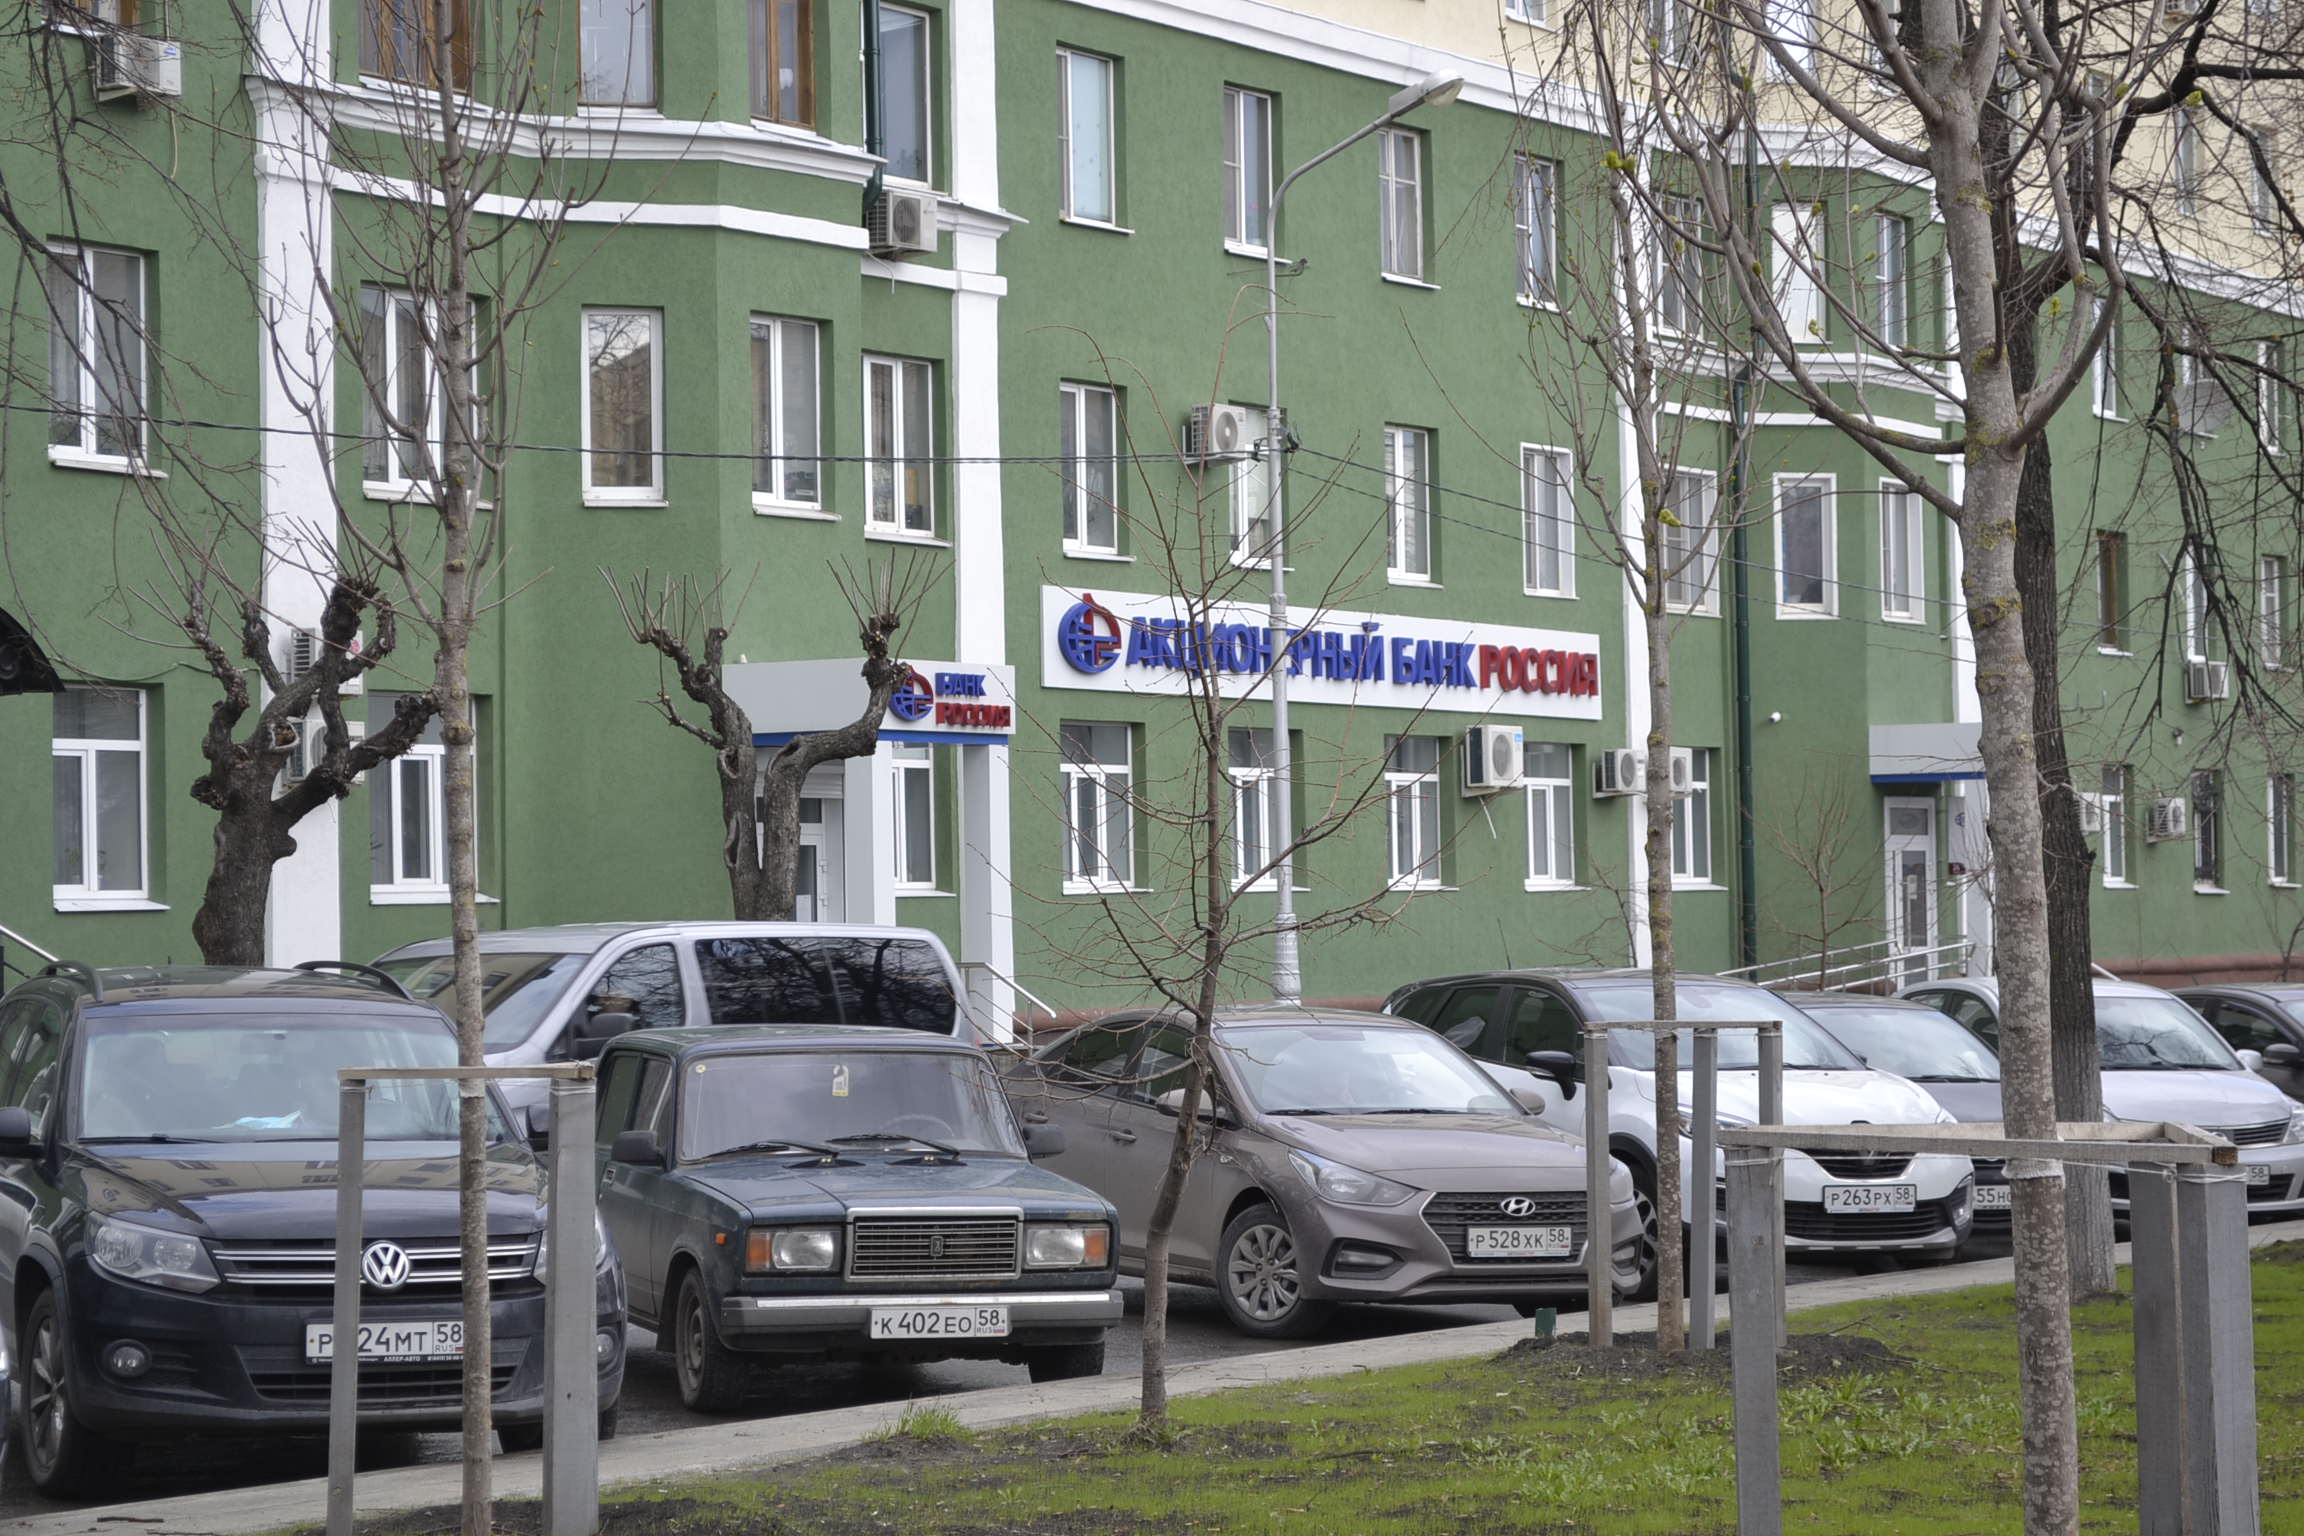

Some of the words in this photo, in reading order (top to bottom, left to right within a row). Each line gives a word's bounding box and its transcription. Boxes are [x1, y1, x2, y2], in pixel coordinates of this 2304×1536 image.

[1391, 637, 1478, 688] БАНК
[1479, 644, 1599, 697] РОССИЯ
[935, 673, 987, 697] БАНК
[936, 702, 1011, 727] РОССИЯ
[1896, 1187, 1910, 1200] 58
[1549, 1229, 1566, 1242] 58
[978, 1310, 1000, 1326] 58
[318, 1326, 428, 1354] Р24МТ
[437, 1323, 462, 1343] 58
